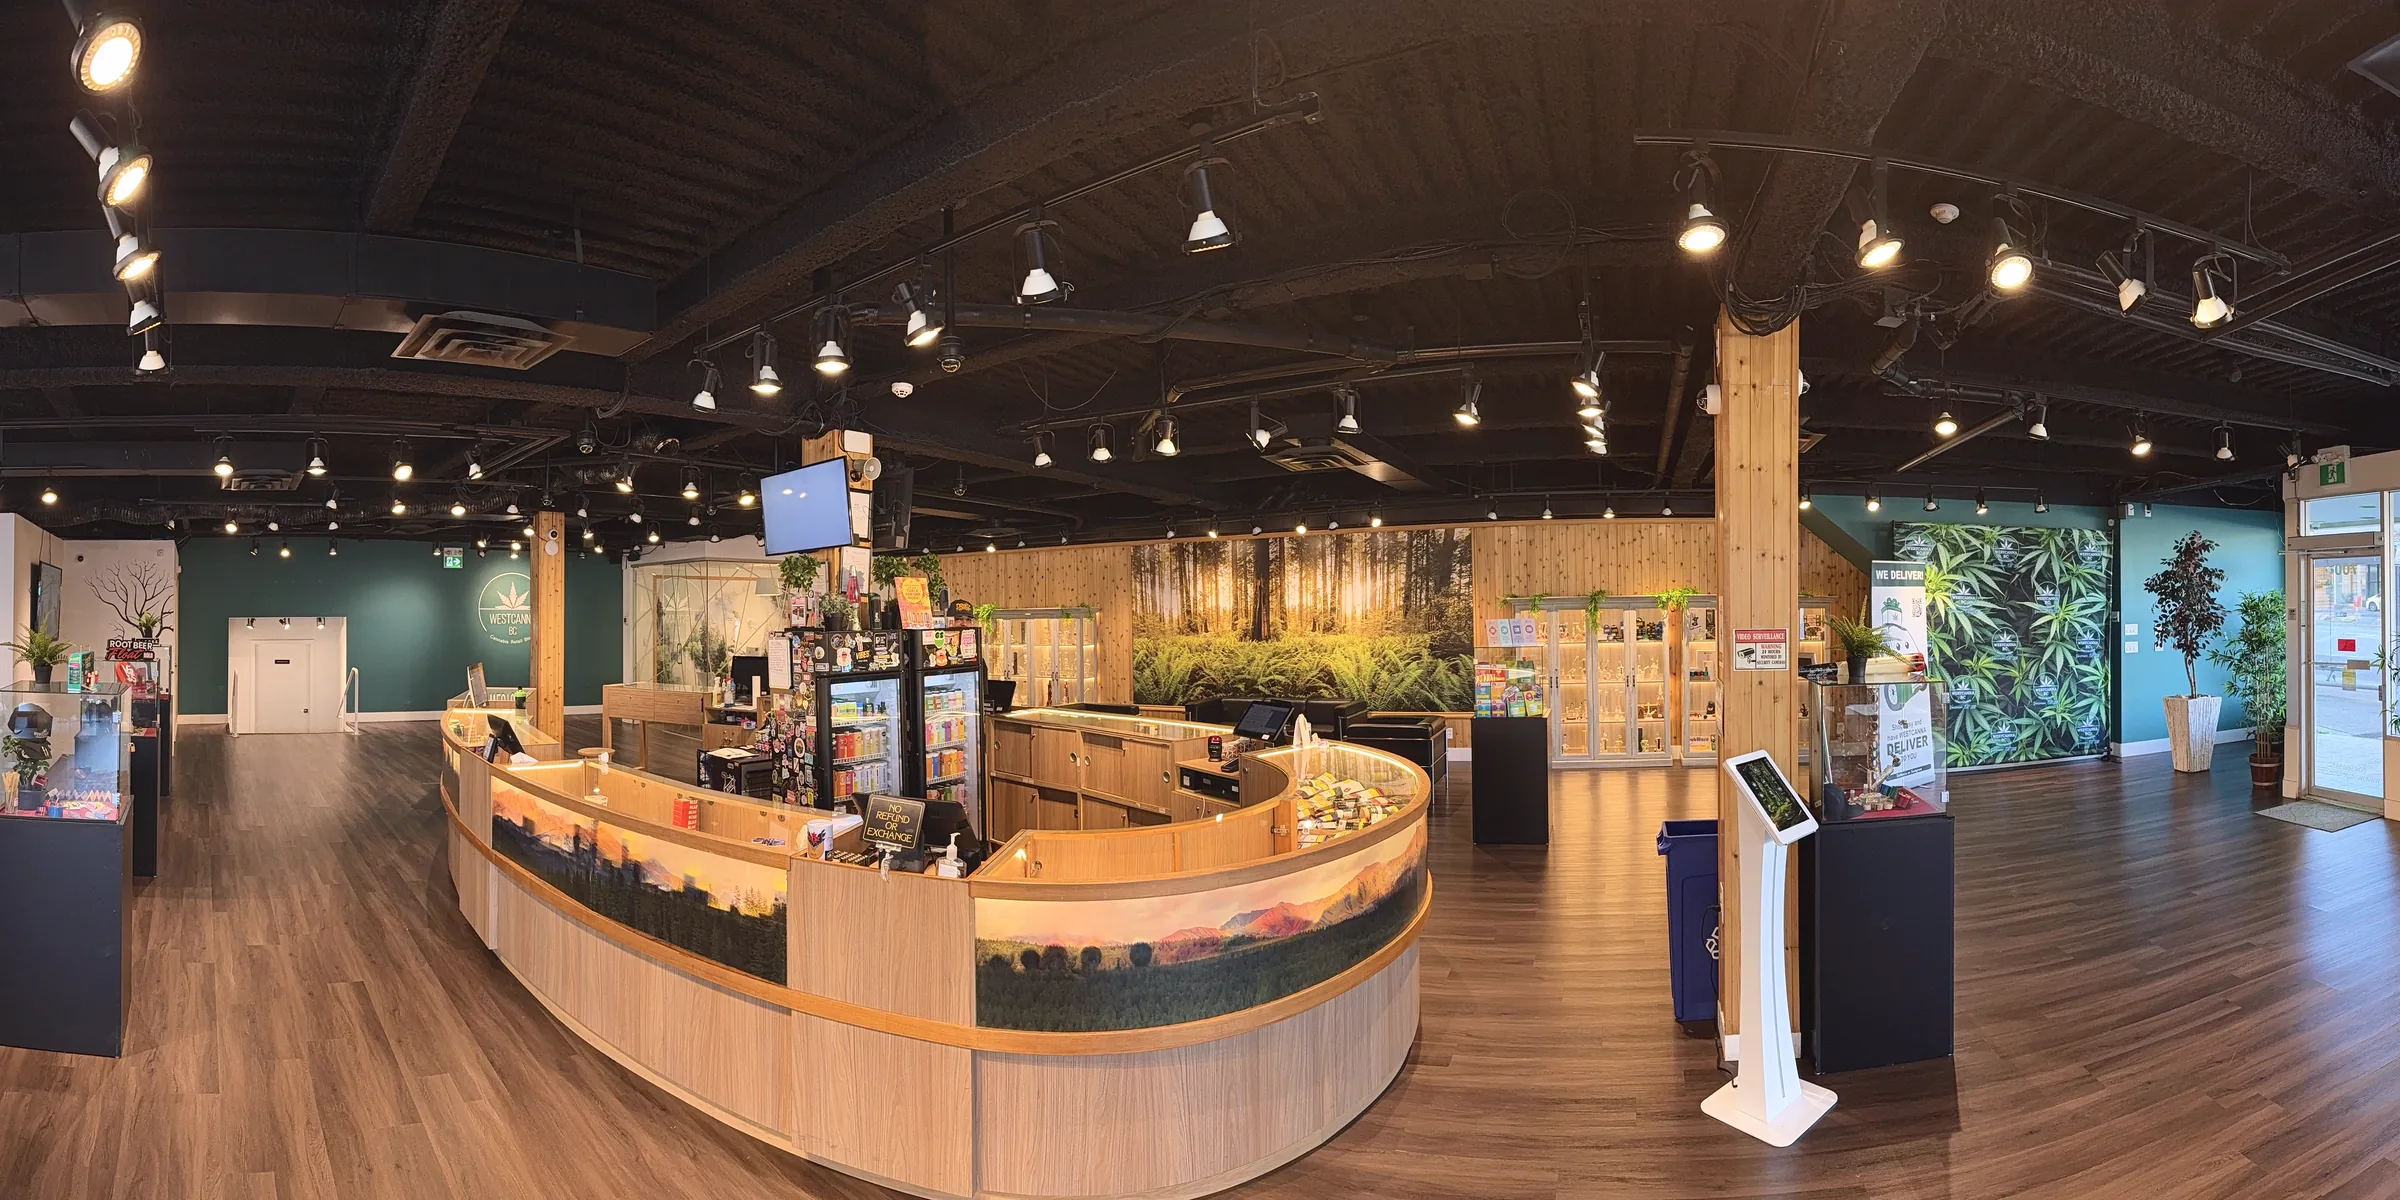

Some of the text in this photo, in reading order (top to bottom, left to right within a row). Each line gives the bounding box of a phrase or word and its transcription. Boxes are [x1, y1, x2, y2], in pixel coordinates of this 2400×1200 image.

[1876, 570, 1924, 580] WE DELIVER!
[508, 626, 517, 636] BC
[490, 634, 509, 644] Cannabis
[109, 640, 133, 648] ROOT
[133, 641, 153, 650] BEER
[108, 648, 144, 660] Float
[1914, 719, 1922, 727] and
[1887, 727, 1927, 742] have WESTCANNA
[1887, 735, 1928, 756] DELIVER
[888, 804, 902, 813] NO
[875, 811, 910, 824] REFUND
[885, 821, 898, 831] OR
[866, 828, 912, 842] EXCHANGE
